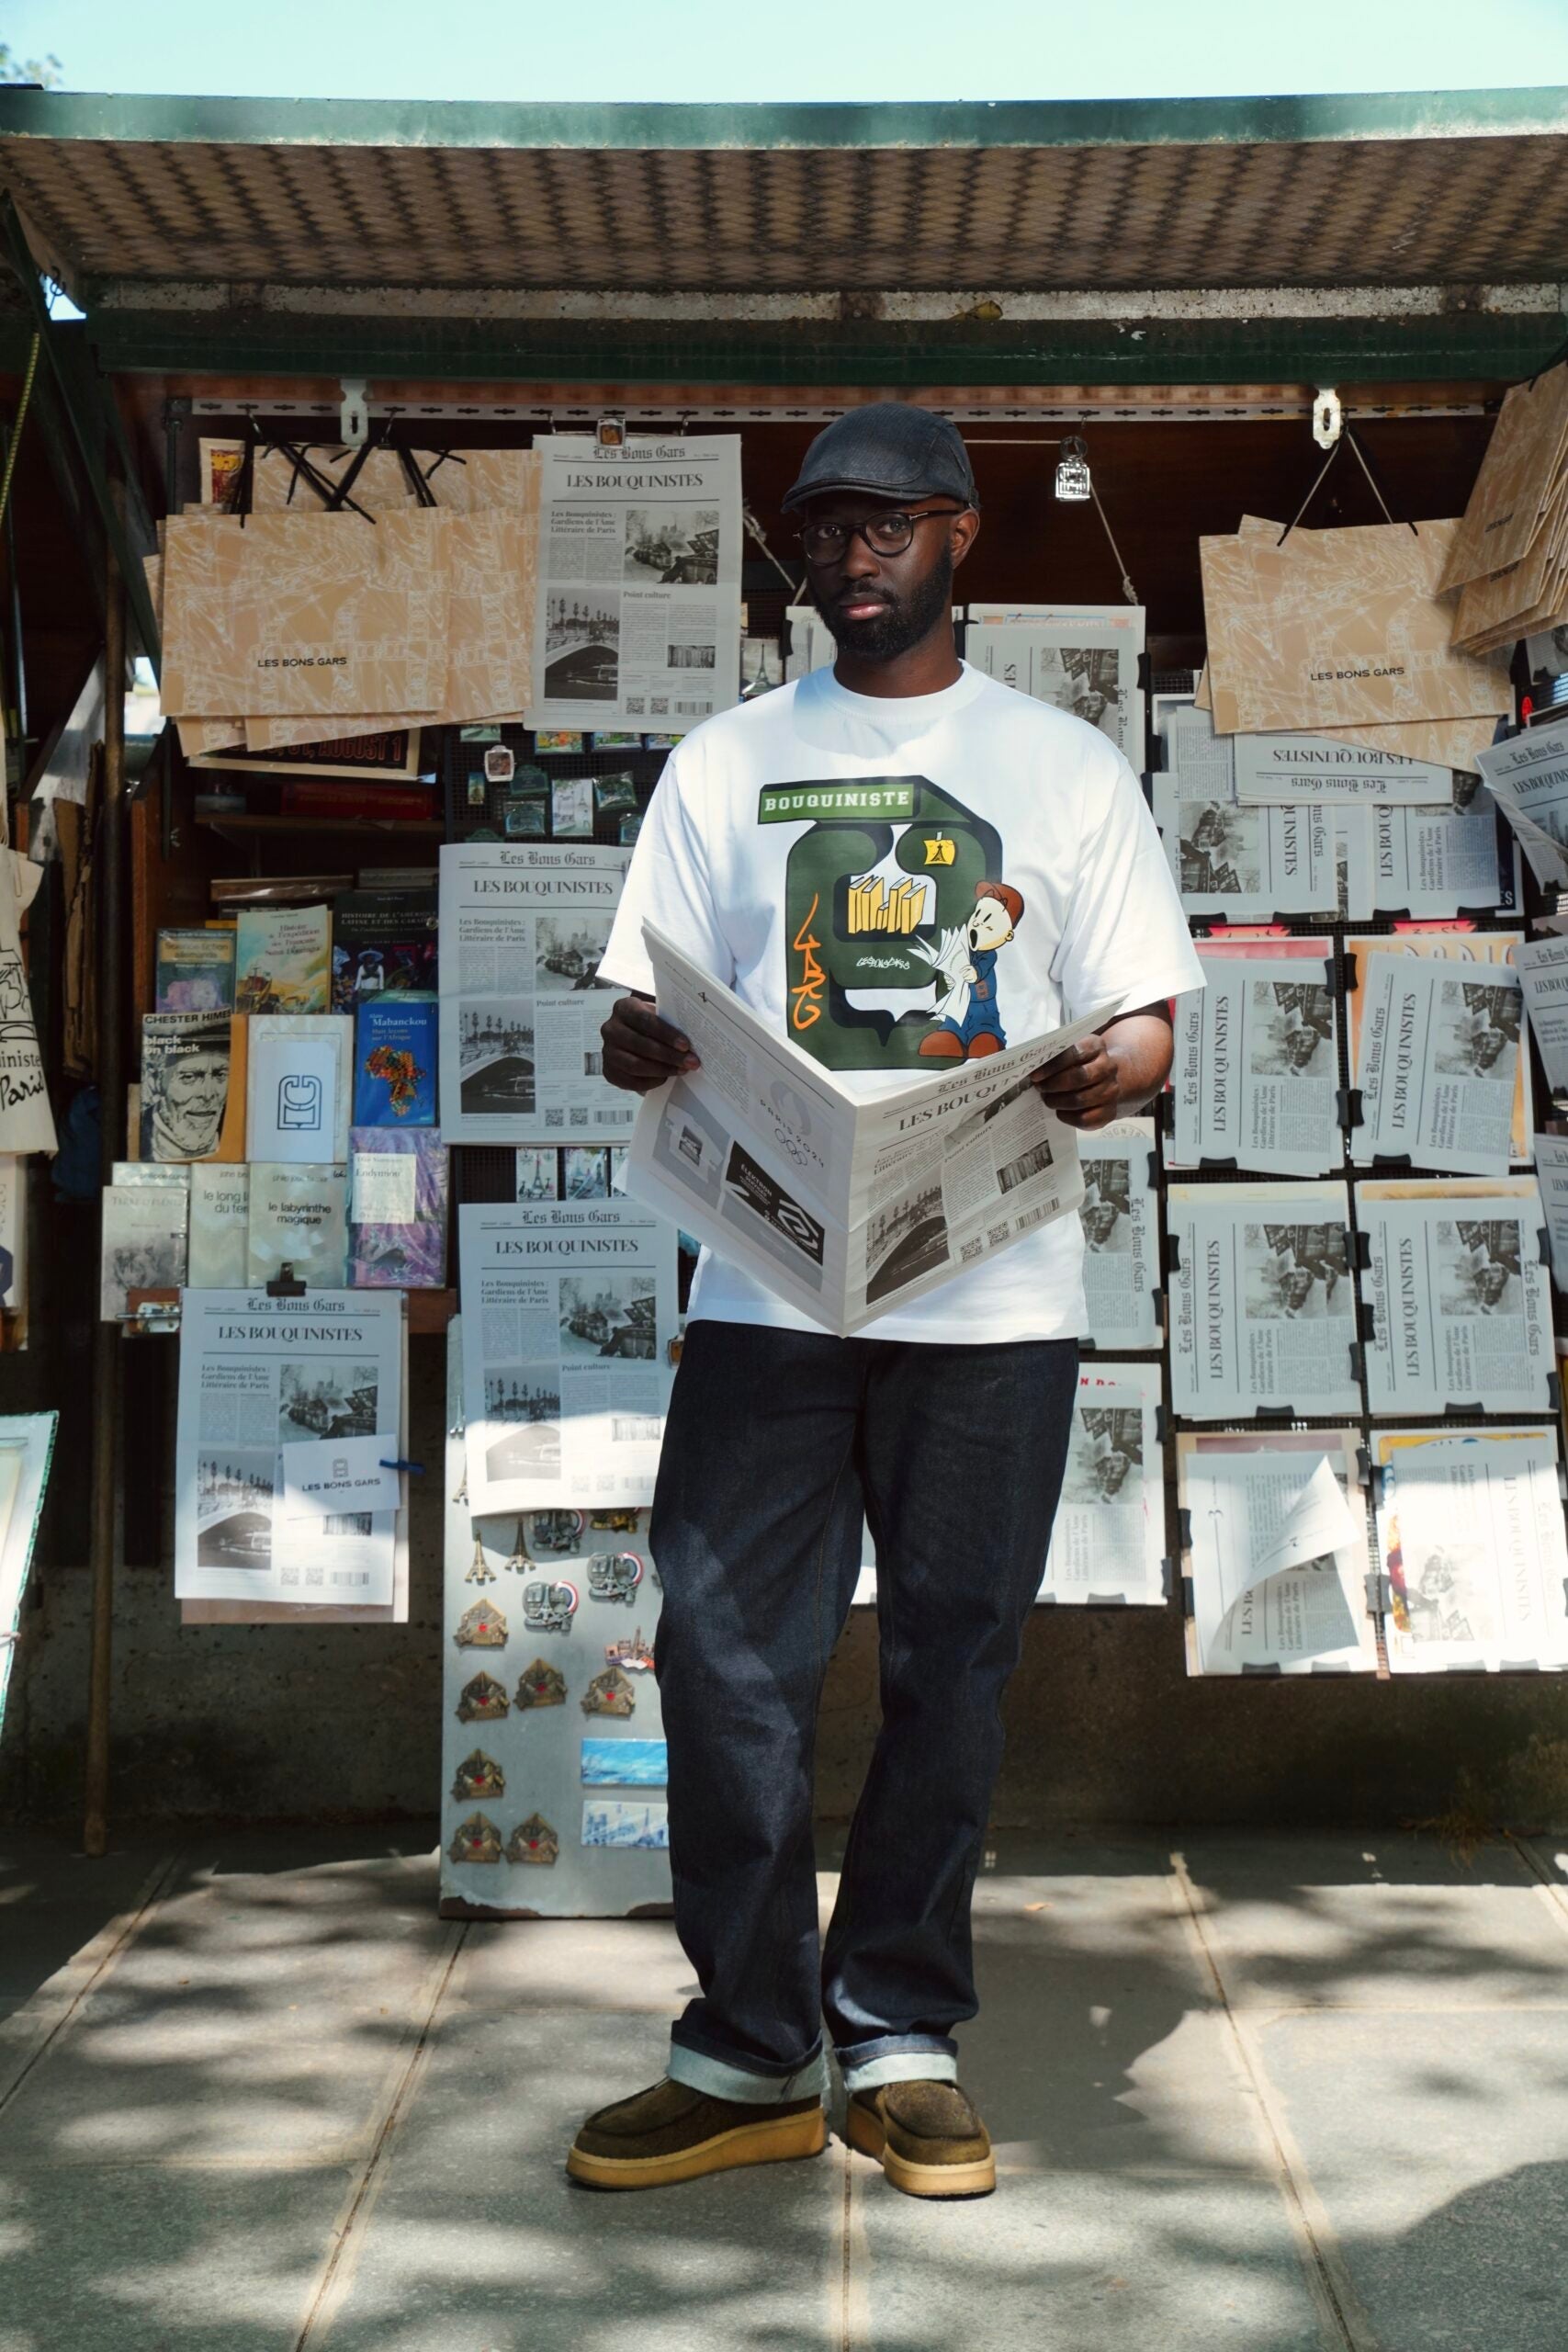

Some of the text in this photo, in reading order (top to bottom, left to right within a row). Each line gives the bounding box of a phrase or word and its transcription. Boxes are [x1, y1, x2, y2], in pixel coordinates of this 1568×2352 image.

[593, 446, 617, 459] Les
[621, 447, 652, 459] Bons
[656, 445, 685, 458] Gars
[568, 473, 704, 490] LES BOUQUINISTES
[283, 658, 314, 667] BONS
[318, 658, 347, 666] GARS
[1310, 667, 1404, 681] LES BONS GARS
[320, 735, 400, 761] AUGUST 1
[1273, 748, 1383, 764] BOUQUINISTES
[1510, 741, 1565, 764] Les Bons Gars
[1292, 778, 1387, 794] Les Bons Gars
[1513, 780, 1532, 795] LES
[764, 791, 909, 811] BOUQUINISTE
[1314, 827, 1325, 858] Gars
[500, 851, 595, 865] Les Bons Gars
[1381, 853, 1393, 878] LES
[474, 880, 614, 896] LES BOUQUINISTES
[1534, 981, 1548, 994] LES
[558, 999, 584, 1007] culture
[144, 1014, 198, 1023] CHESTER
[373, 1017, 426, 1026] Mabanckou
[144, 1035, 182, 1046] black
[143, 1044, 200, 1055] on black
[1363, 1007, 1385, 1101] Les Bons Gars
[1184, 1012, 1199, 1105] Les Bons Gars
[1213, 995, 1230, 1132] LES BOUQUINISTES
[1392, 993, 1416, 1129] LES BOUQUINISTES
[938, 1079, 967, 1095] Les
[974, 1060, 1015, 1080] Bons
[898, 1108, 933, 1131] LES
[760, 1099, 824, 1168] PARIS 2024
[356, 1169, 400, 1180] Endymion
[740, 1163, 772, 1196] ELEKTRON
[204, 1191, 213, 1200] le
[217, 1191, 241, 1204] long
[215, 1204, 230, 1213] du
[268, 1203, 331, 1213] le labyrinthe
[276, 1215, 321, 1226] magique
[522, 1209, 621, 1224] Les Bons Gars
[496, 1239, 639, 1257] LES BOUQUINISTES
[1131, 1198, 1147, 1293] Les Bons Gars
[248, 1298, 345, 1312] Les Bons Gars
[1178, 1257, 1192, 1354] Les Bons Gars
[1207, 1239, 1224, 1378] LES BOUQUINISTES
[1371, 1257, 1389, 1352] Les Bons Gars
[1400, 1238, 1420, 1378] LES BOUQUINISTES
[1523, 1259, 1543, 1356] Les Bons Gars
[219, 1327, 363, 1343] LES BOUQUINISTES
[302, 1479, 380, 1492] LES BONS GARS
[1241, 1604, 1253, 1635] LES
